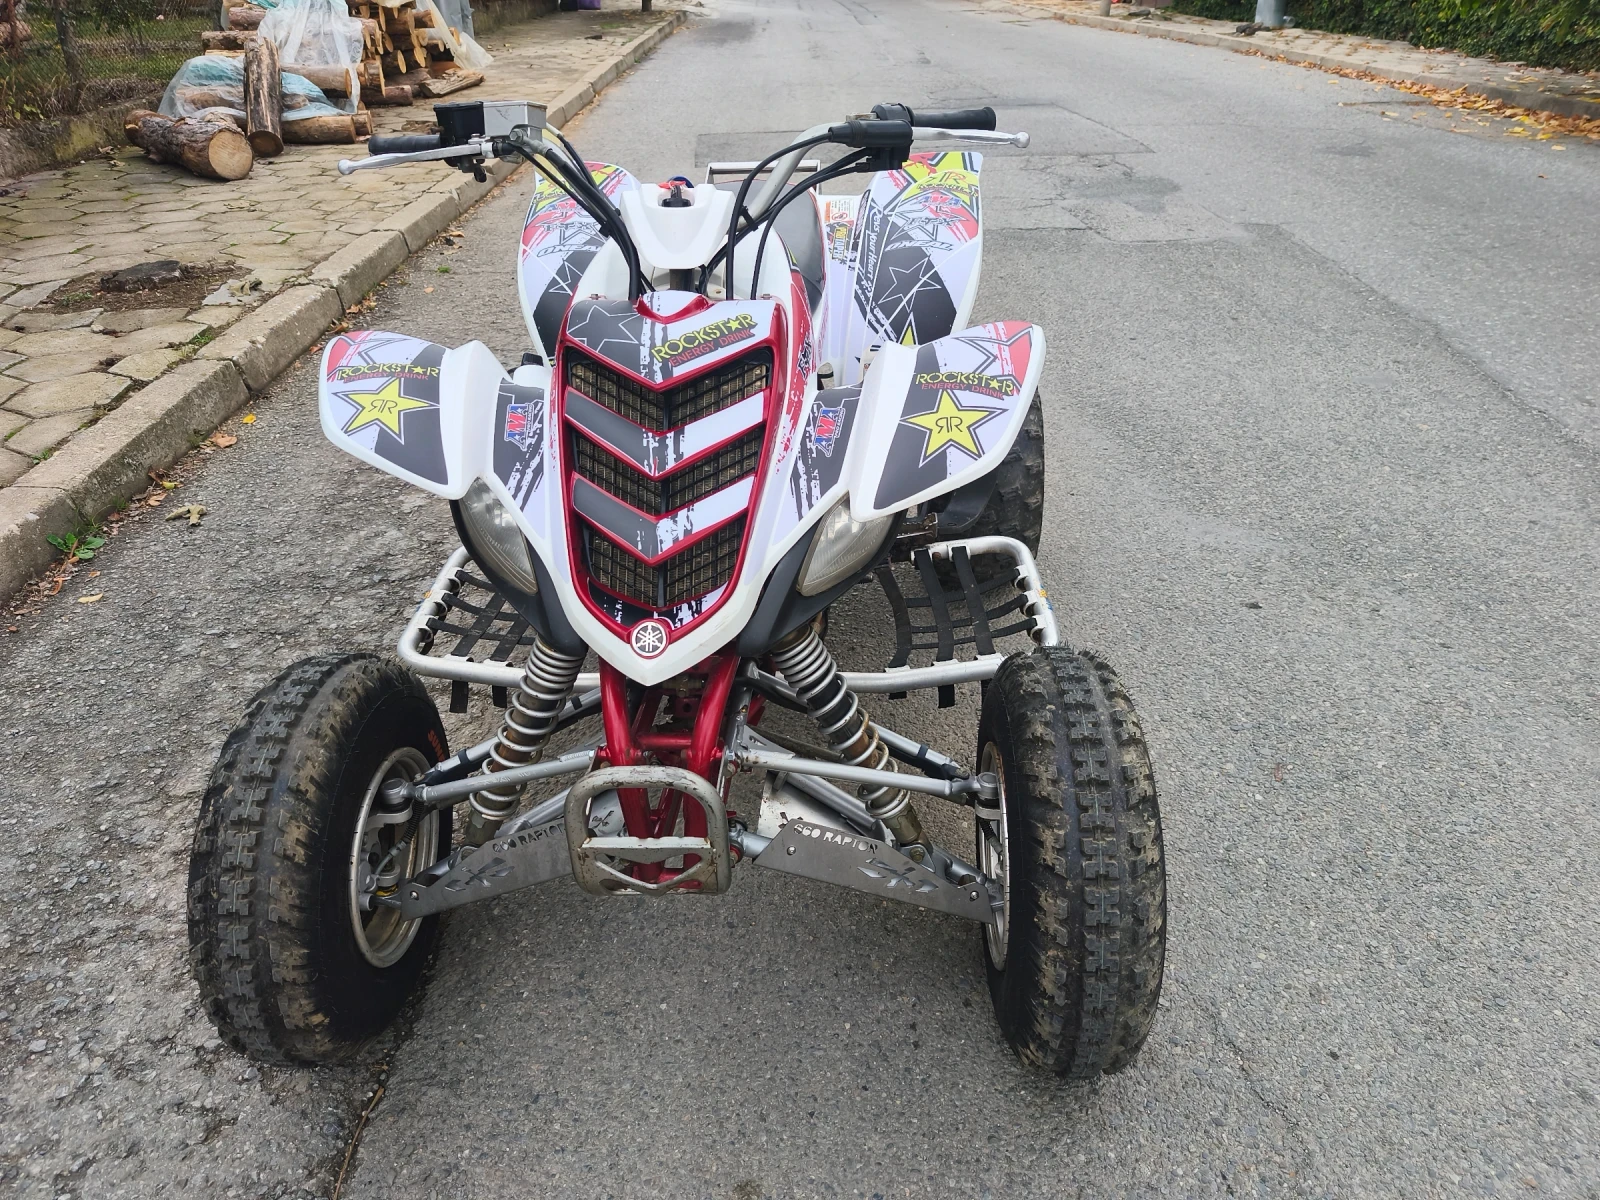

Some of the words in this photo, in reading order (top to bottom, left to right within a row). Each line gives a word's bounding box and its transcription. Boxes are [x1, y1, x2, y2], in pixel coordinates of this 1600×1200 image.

[669, 341, 715, 367] ENERGY
[719, 329, 755, 347] DRINK
[343, 372, 389, 383] ENERGY
[397, 372, 429, 380] DRINK
[972, 385, 1004, 399] DRINK
[793, 823, 821, 838] 660
[823, 831, 878, 854] RAPTOR
